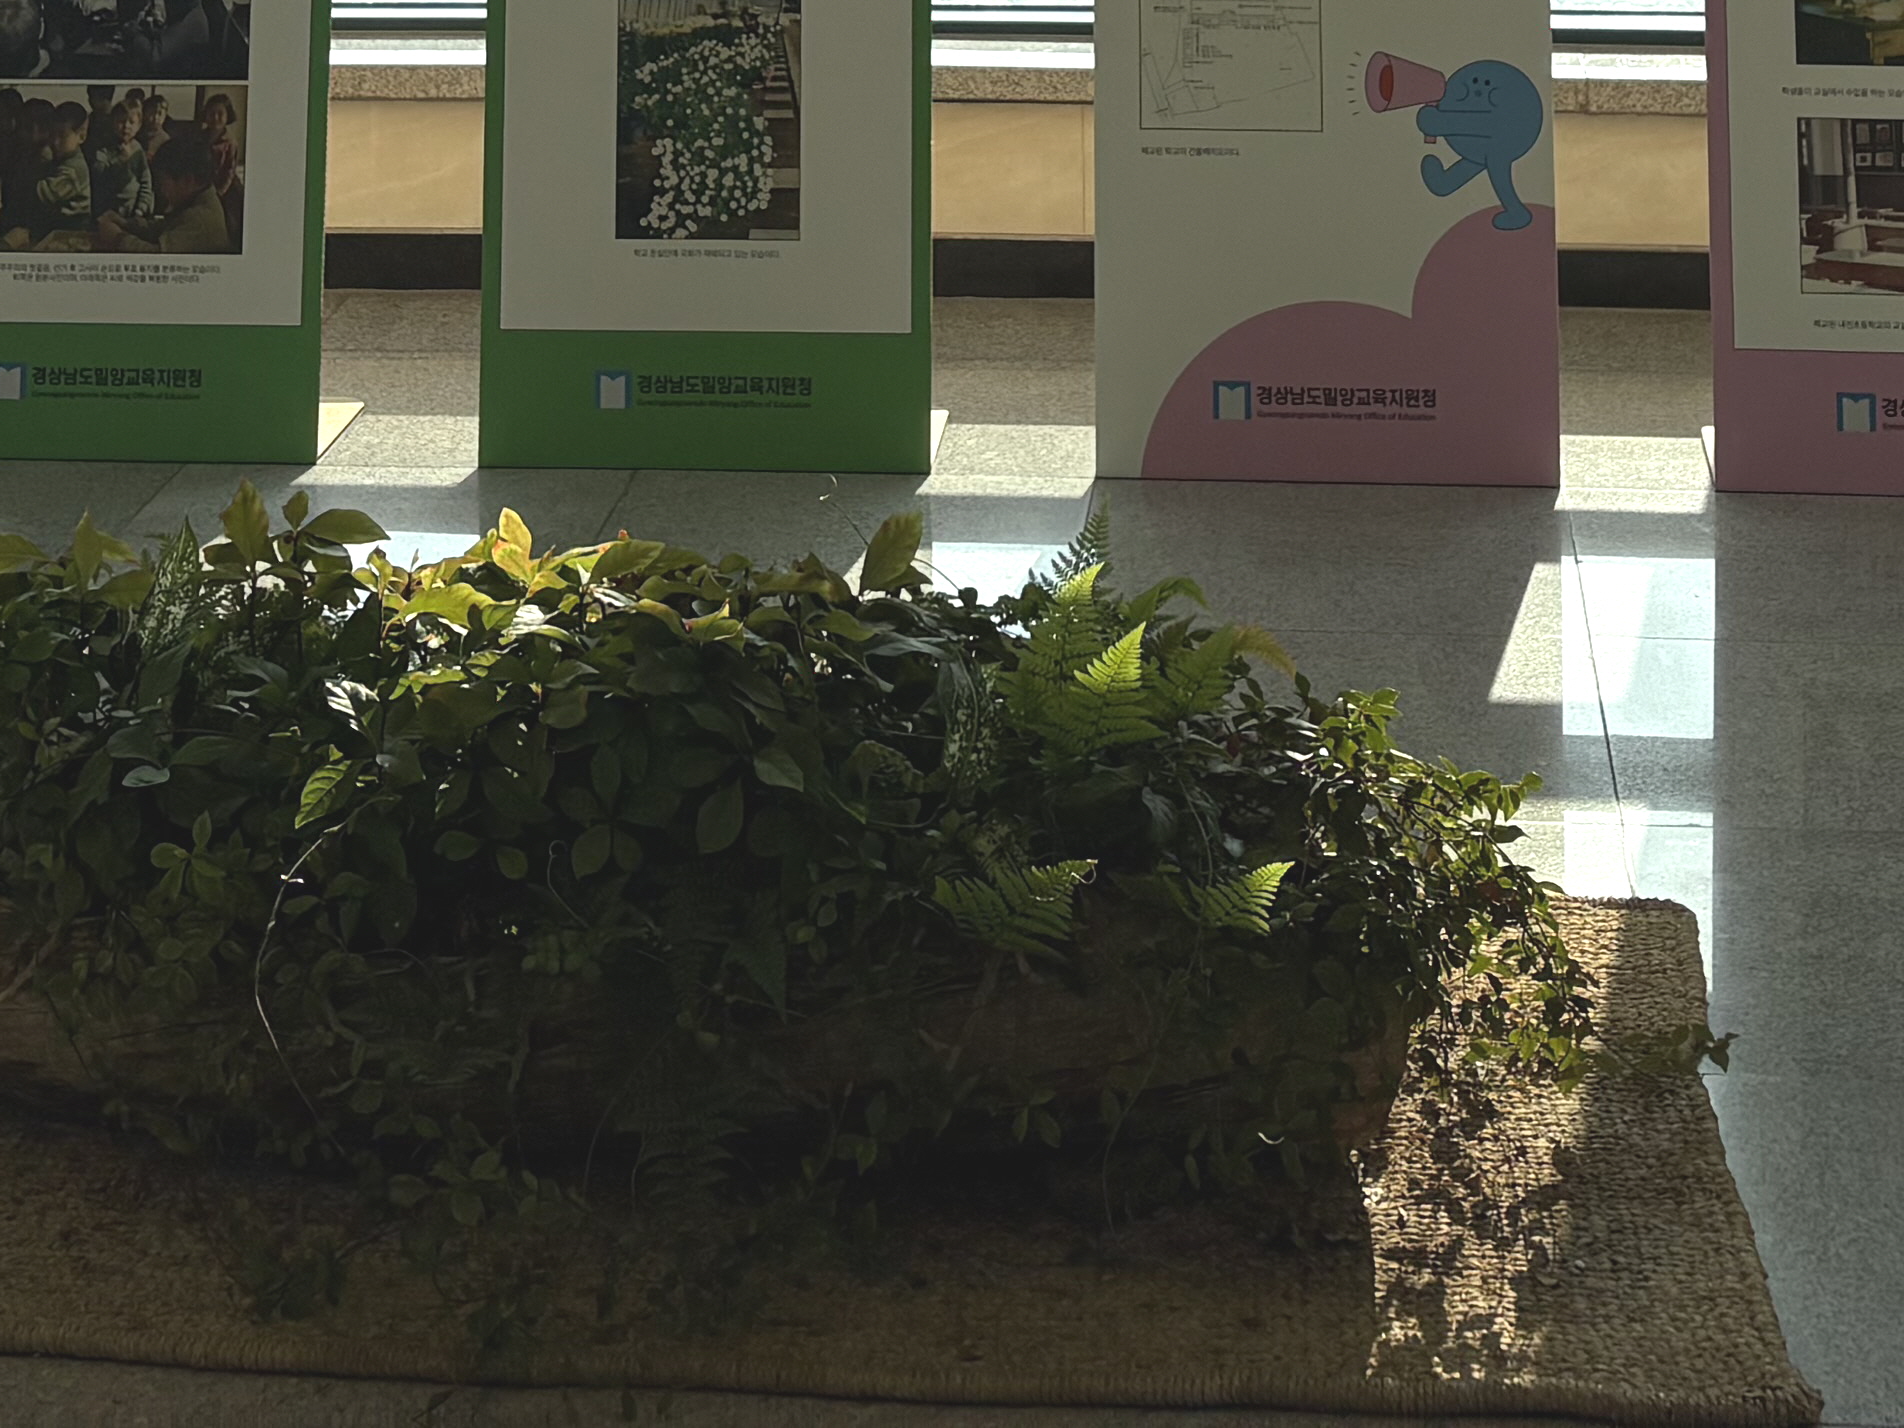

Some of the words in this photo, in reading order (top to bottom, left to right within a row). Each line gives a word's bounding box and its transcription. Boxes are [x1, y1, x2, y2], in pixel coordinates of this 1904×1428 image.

[32, 367, 201, 389] 경상남도밀양교육지원청
[637, 375, 812, 397] 경상남도밀양교육지원청
[1256, 386, 1436, 409] 경상남도밀양교육지원청
